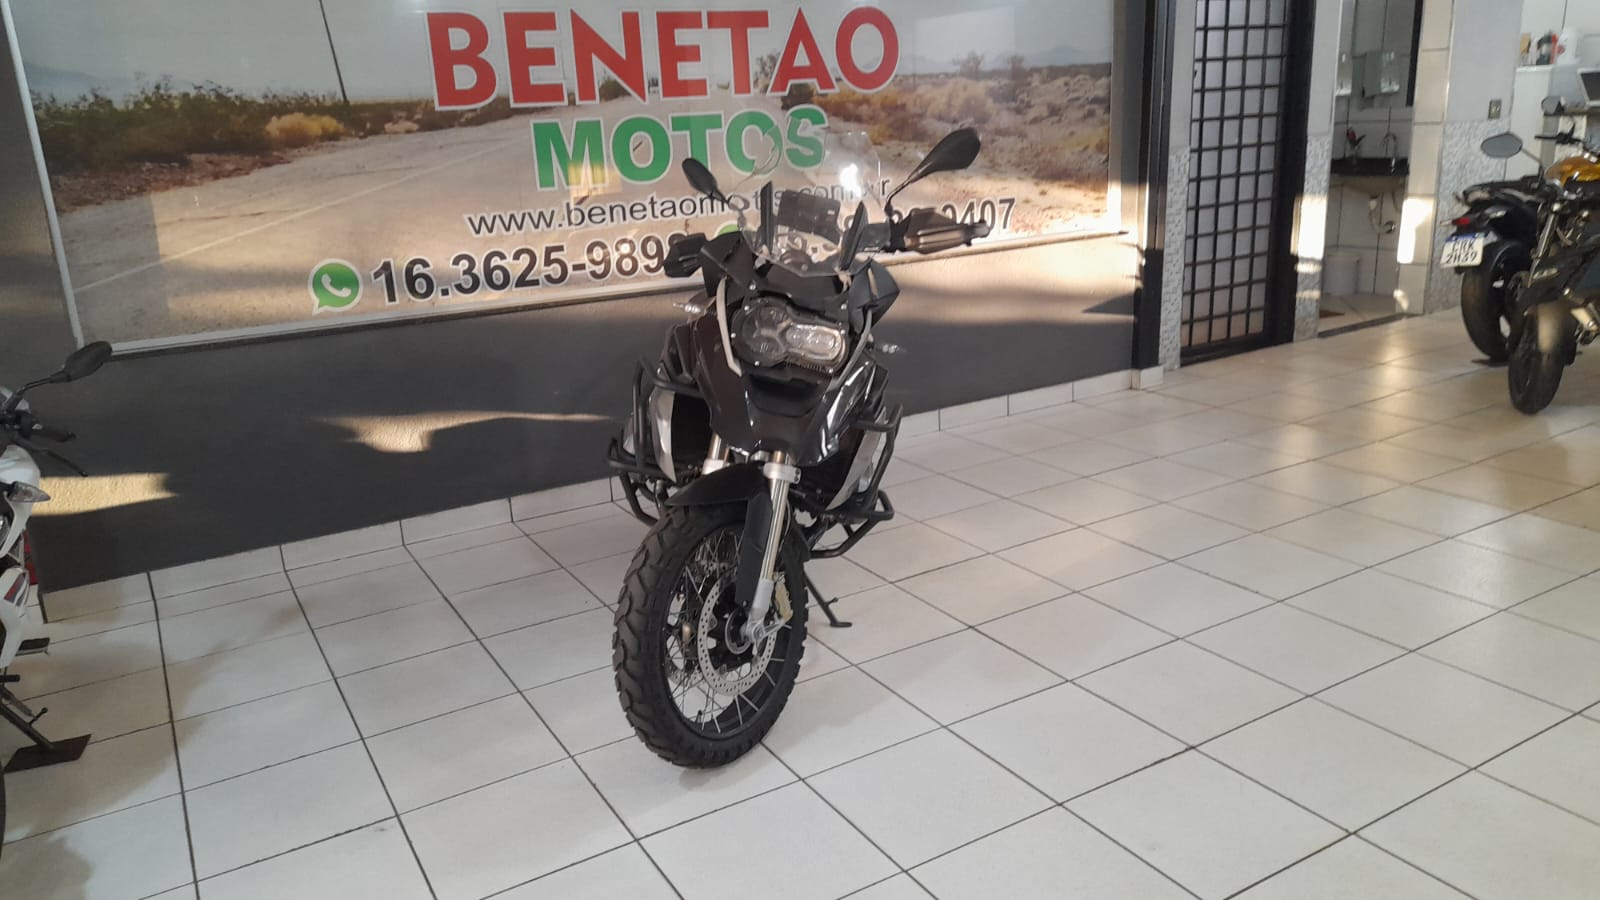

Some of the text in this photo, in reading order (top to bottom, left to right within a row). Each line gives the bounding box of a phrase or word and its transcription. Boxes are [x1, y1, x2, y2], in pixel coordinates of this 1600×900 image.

[427, 7, 899, 108] BENETAO
[533, 107, 826, 188] MOTOS
[372, 232, 688, 304] 16.3625-989
